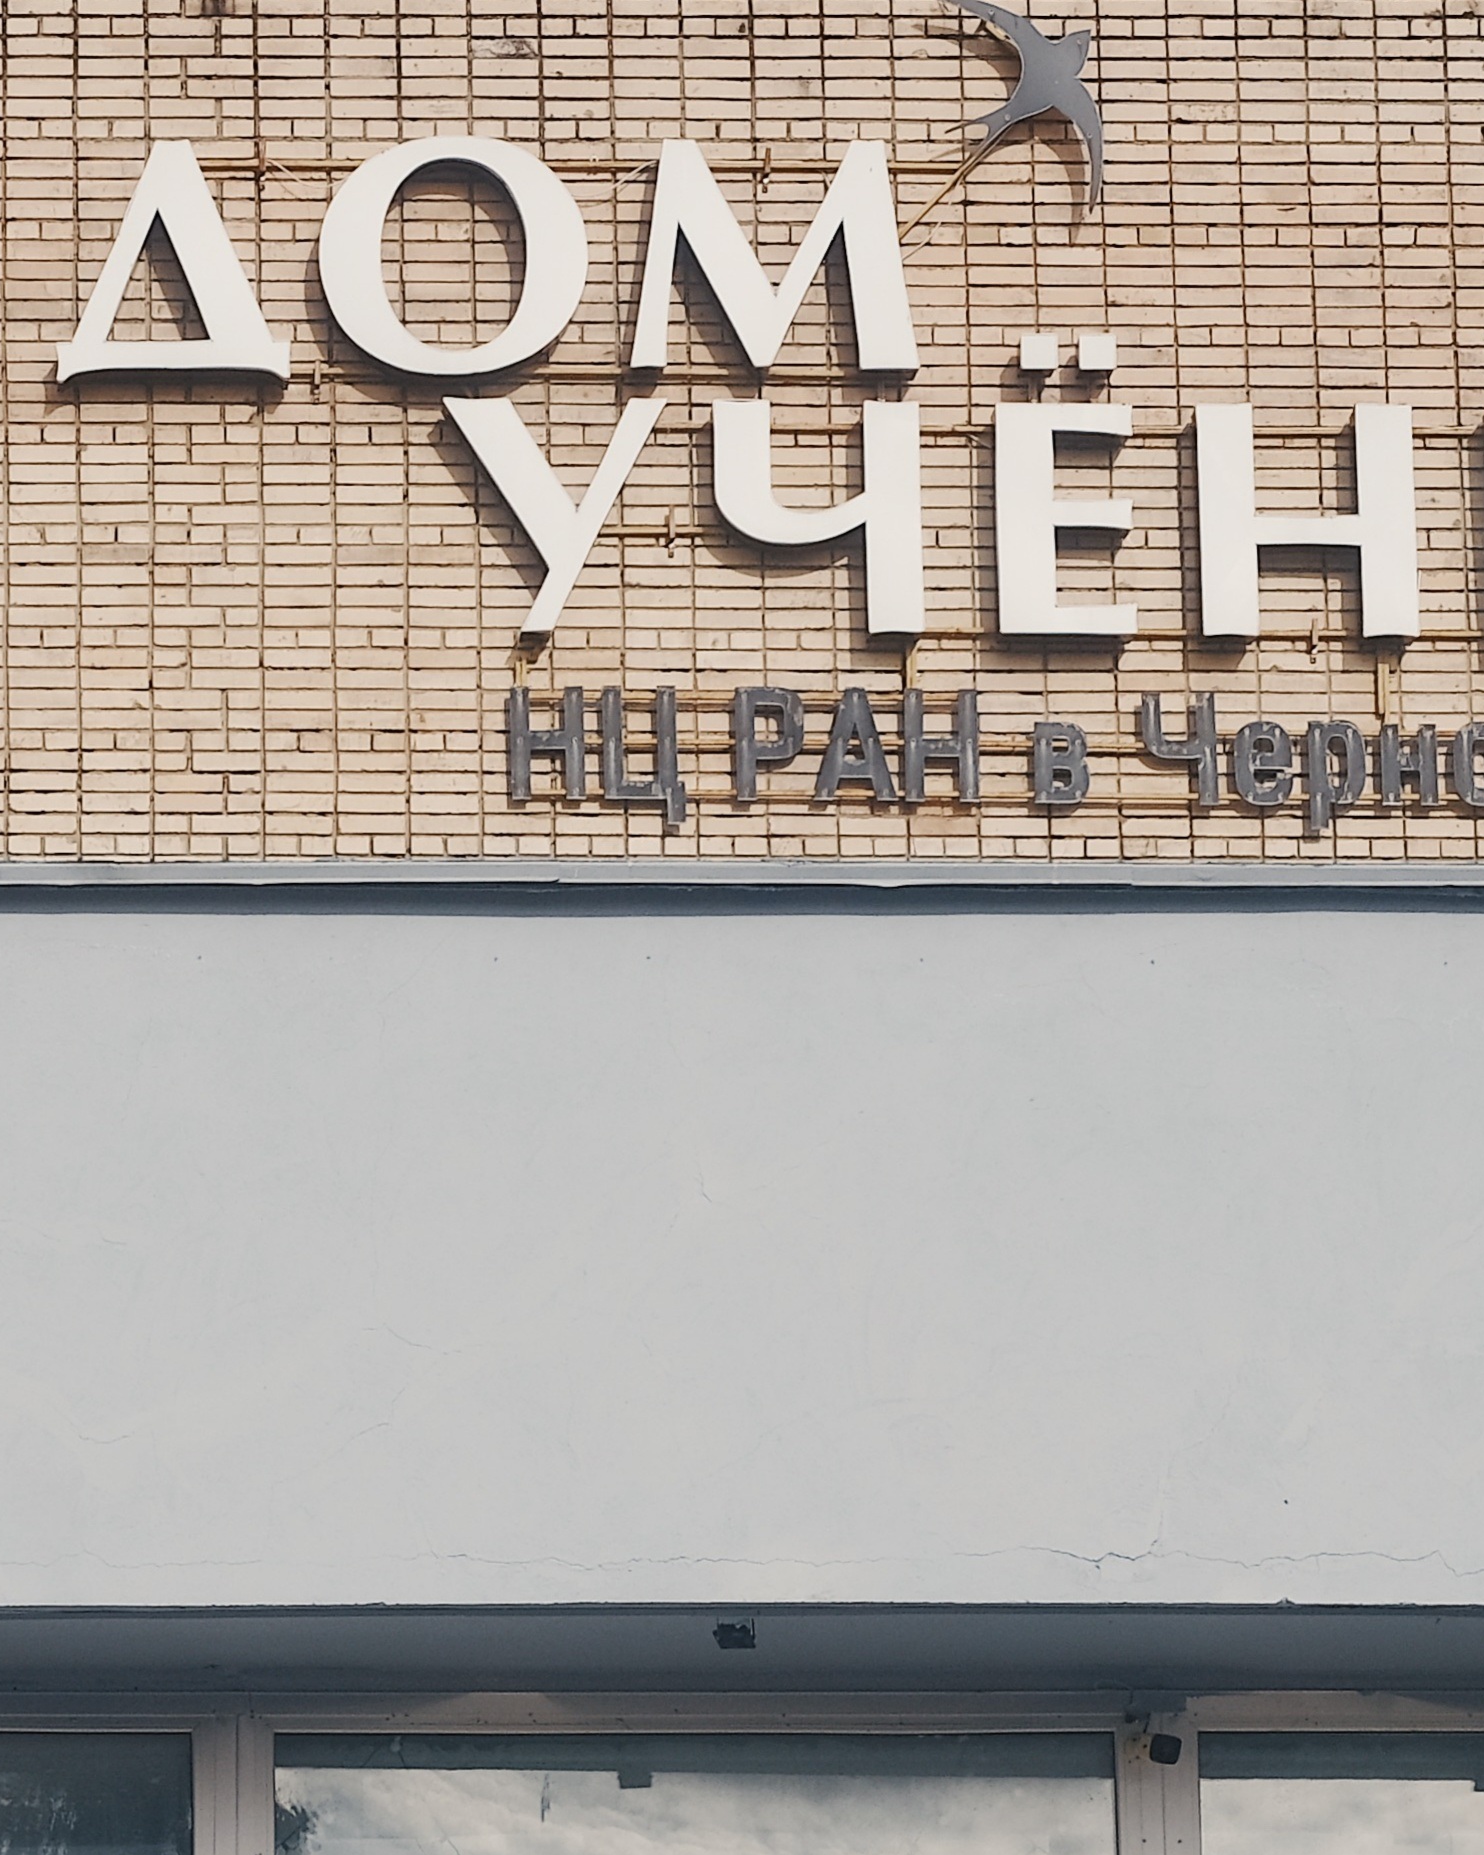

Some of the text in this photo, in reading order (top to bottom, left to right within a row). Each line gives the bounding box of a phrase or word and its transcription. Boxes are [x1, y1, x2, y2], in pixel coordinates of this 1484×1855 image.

[56, 134, 920, 384] ДОМ
[505, 685, 687, 834] НЦ
[734, 686, 982, 808] РАН
[1032, 719, 1090, 806] в
